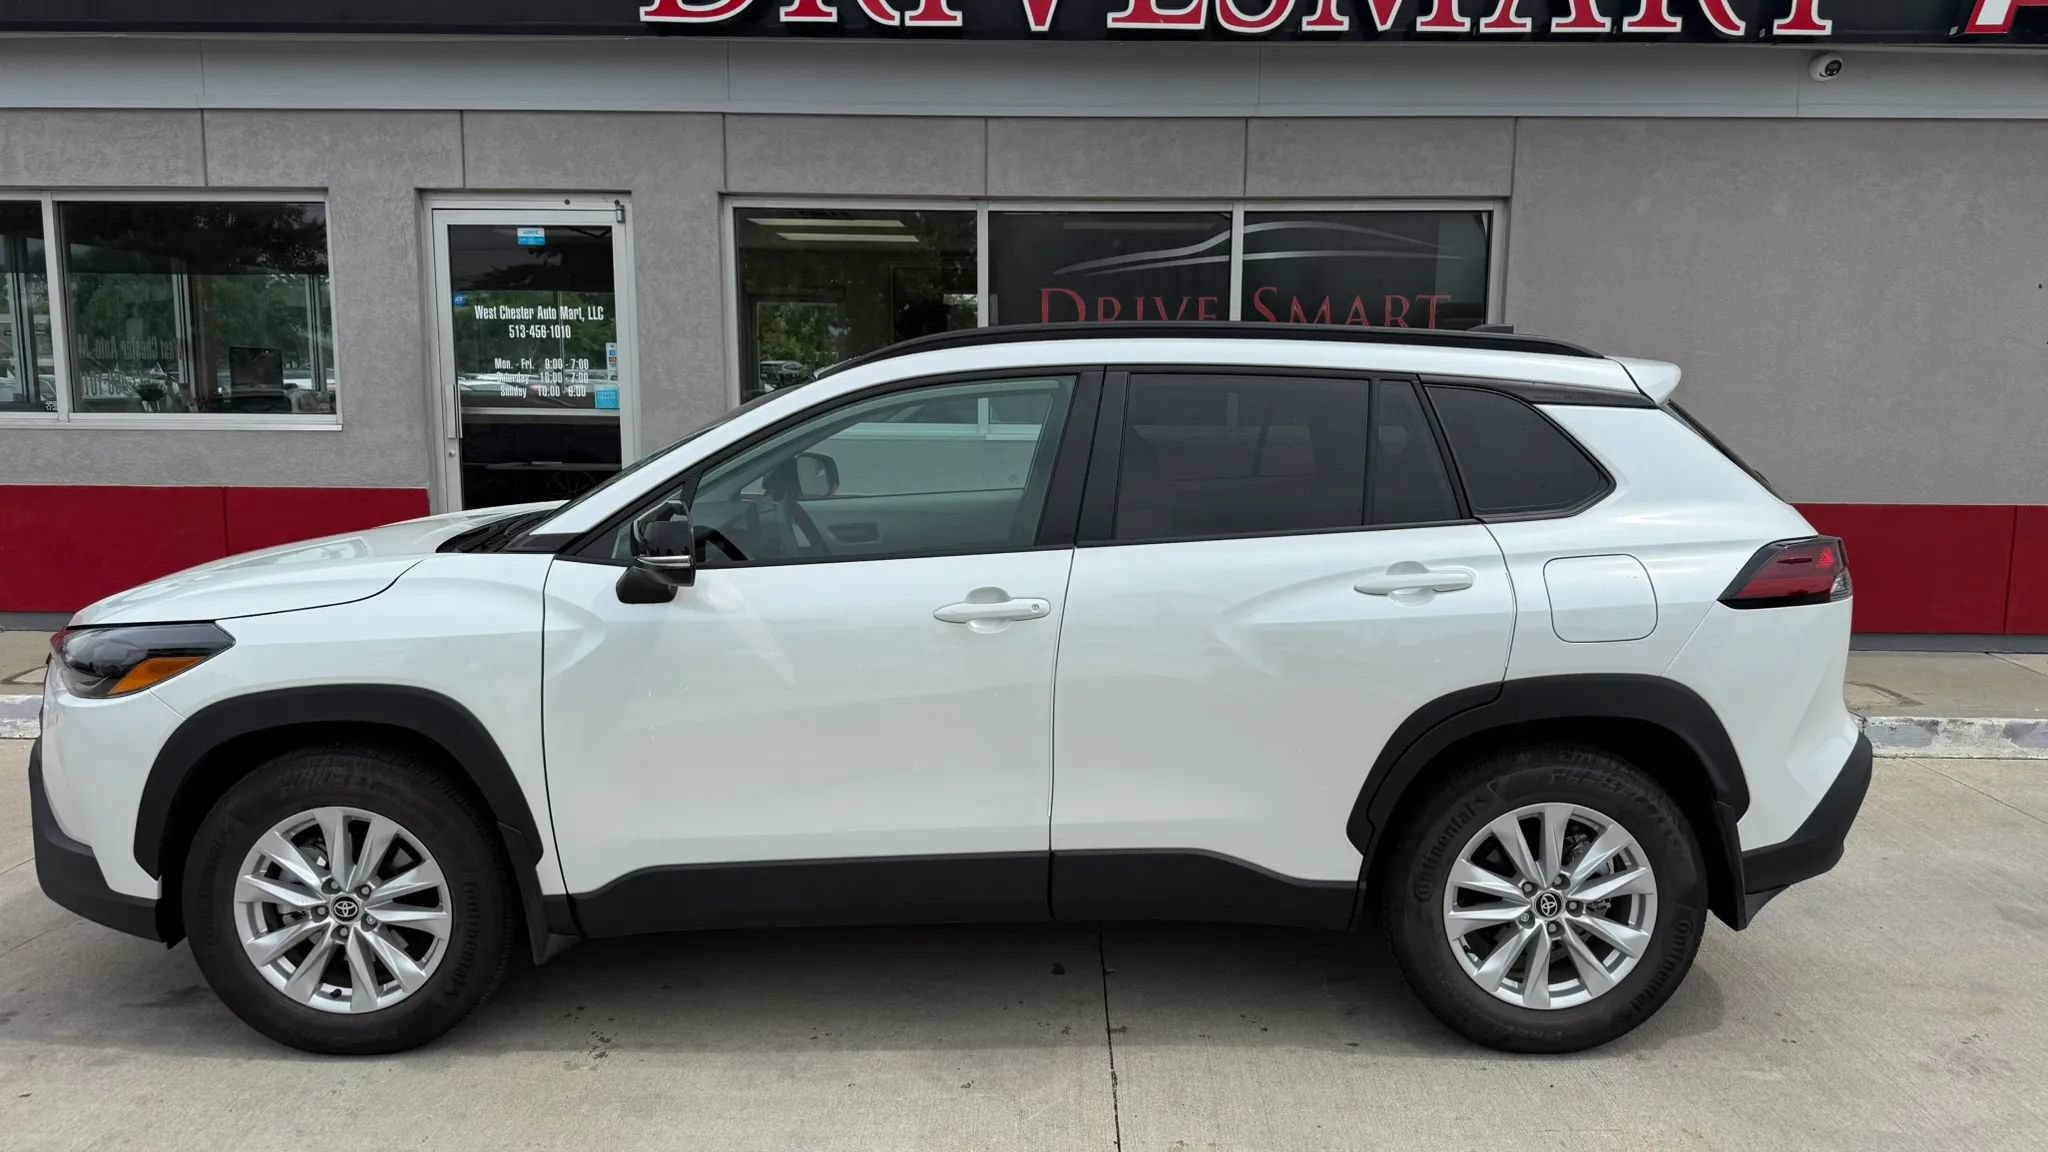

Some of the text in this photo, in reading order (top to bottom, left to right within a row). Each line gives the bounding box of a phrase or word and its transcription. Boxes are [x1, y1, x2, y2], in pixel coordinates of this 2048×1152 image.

[474, 305, 604, 322] West Chester Auto Mart, LLC
[1040, 286, 1452, 329] DRIVE SMART
[509, 324, 572, 339] 513-456-1010
[494, 358, 513, 369] Mon.
[521, 358, 535, 369] Fri.
[570, 358, 589, 369] 7:00
[540, 372, 563, 383] 10:00
[500, 385, 527, 398] Sunday
[538, 385, 560, 397] 10:00
[1412, 801, 1477, 903] Continental
